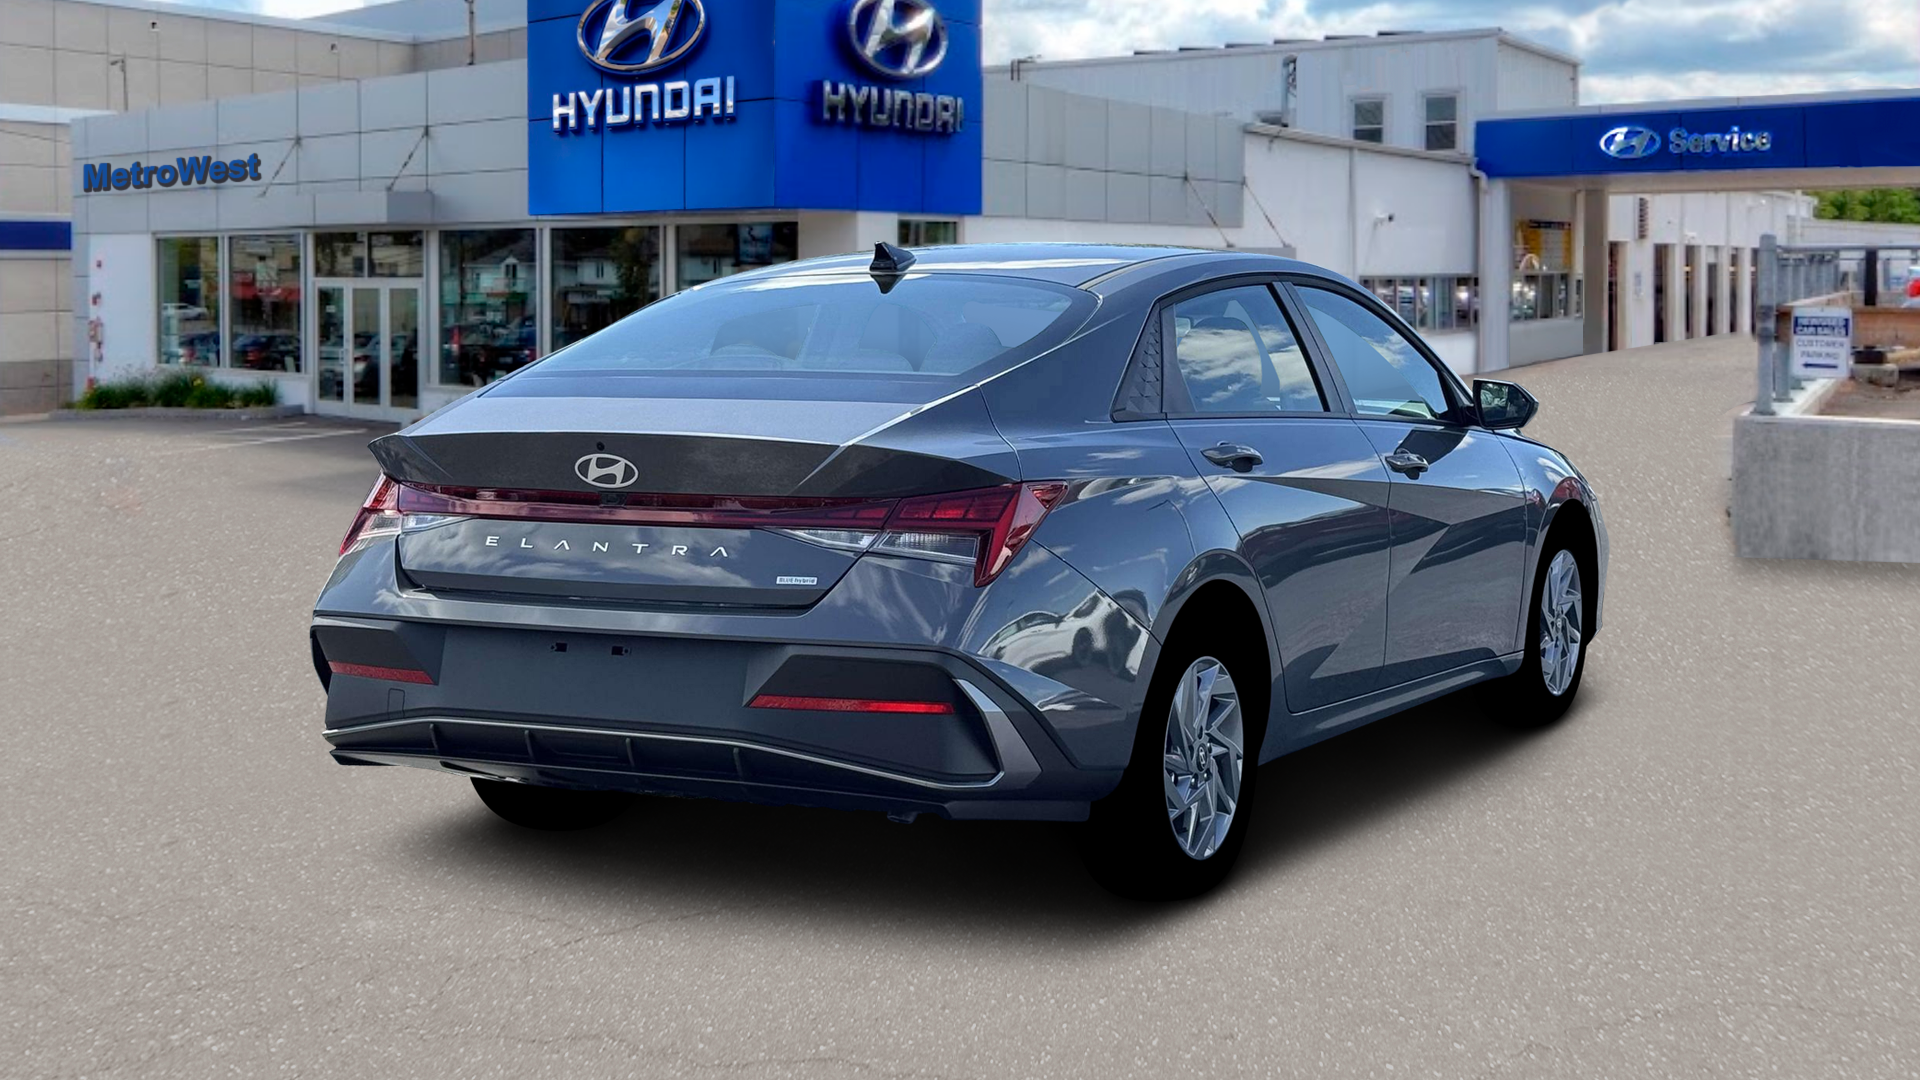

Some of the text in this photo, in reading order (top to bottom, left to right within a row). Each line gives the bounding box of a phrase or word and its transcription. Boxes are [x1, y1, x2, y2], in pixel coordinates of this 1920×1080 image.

[552, 76, 735, 133] HYUNDAI
[822, 80, 964, 133] HYUNDAI
[1668, 126, 1771, 153] Service
[83, 152, 262, 193] MetroWest
[1796, 339, 1845, 348] CUSTOMER
[1800, 350, 1840, 360] PARKING
[485, 535, 729, 558] ELANTRA
